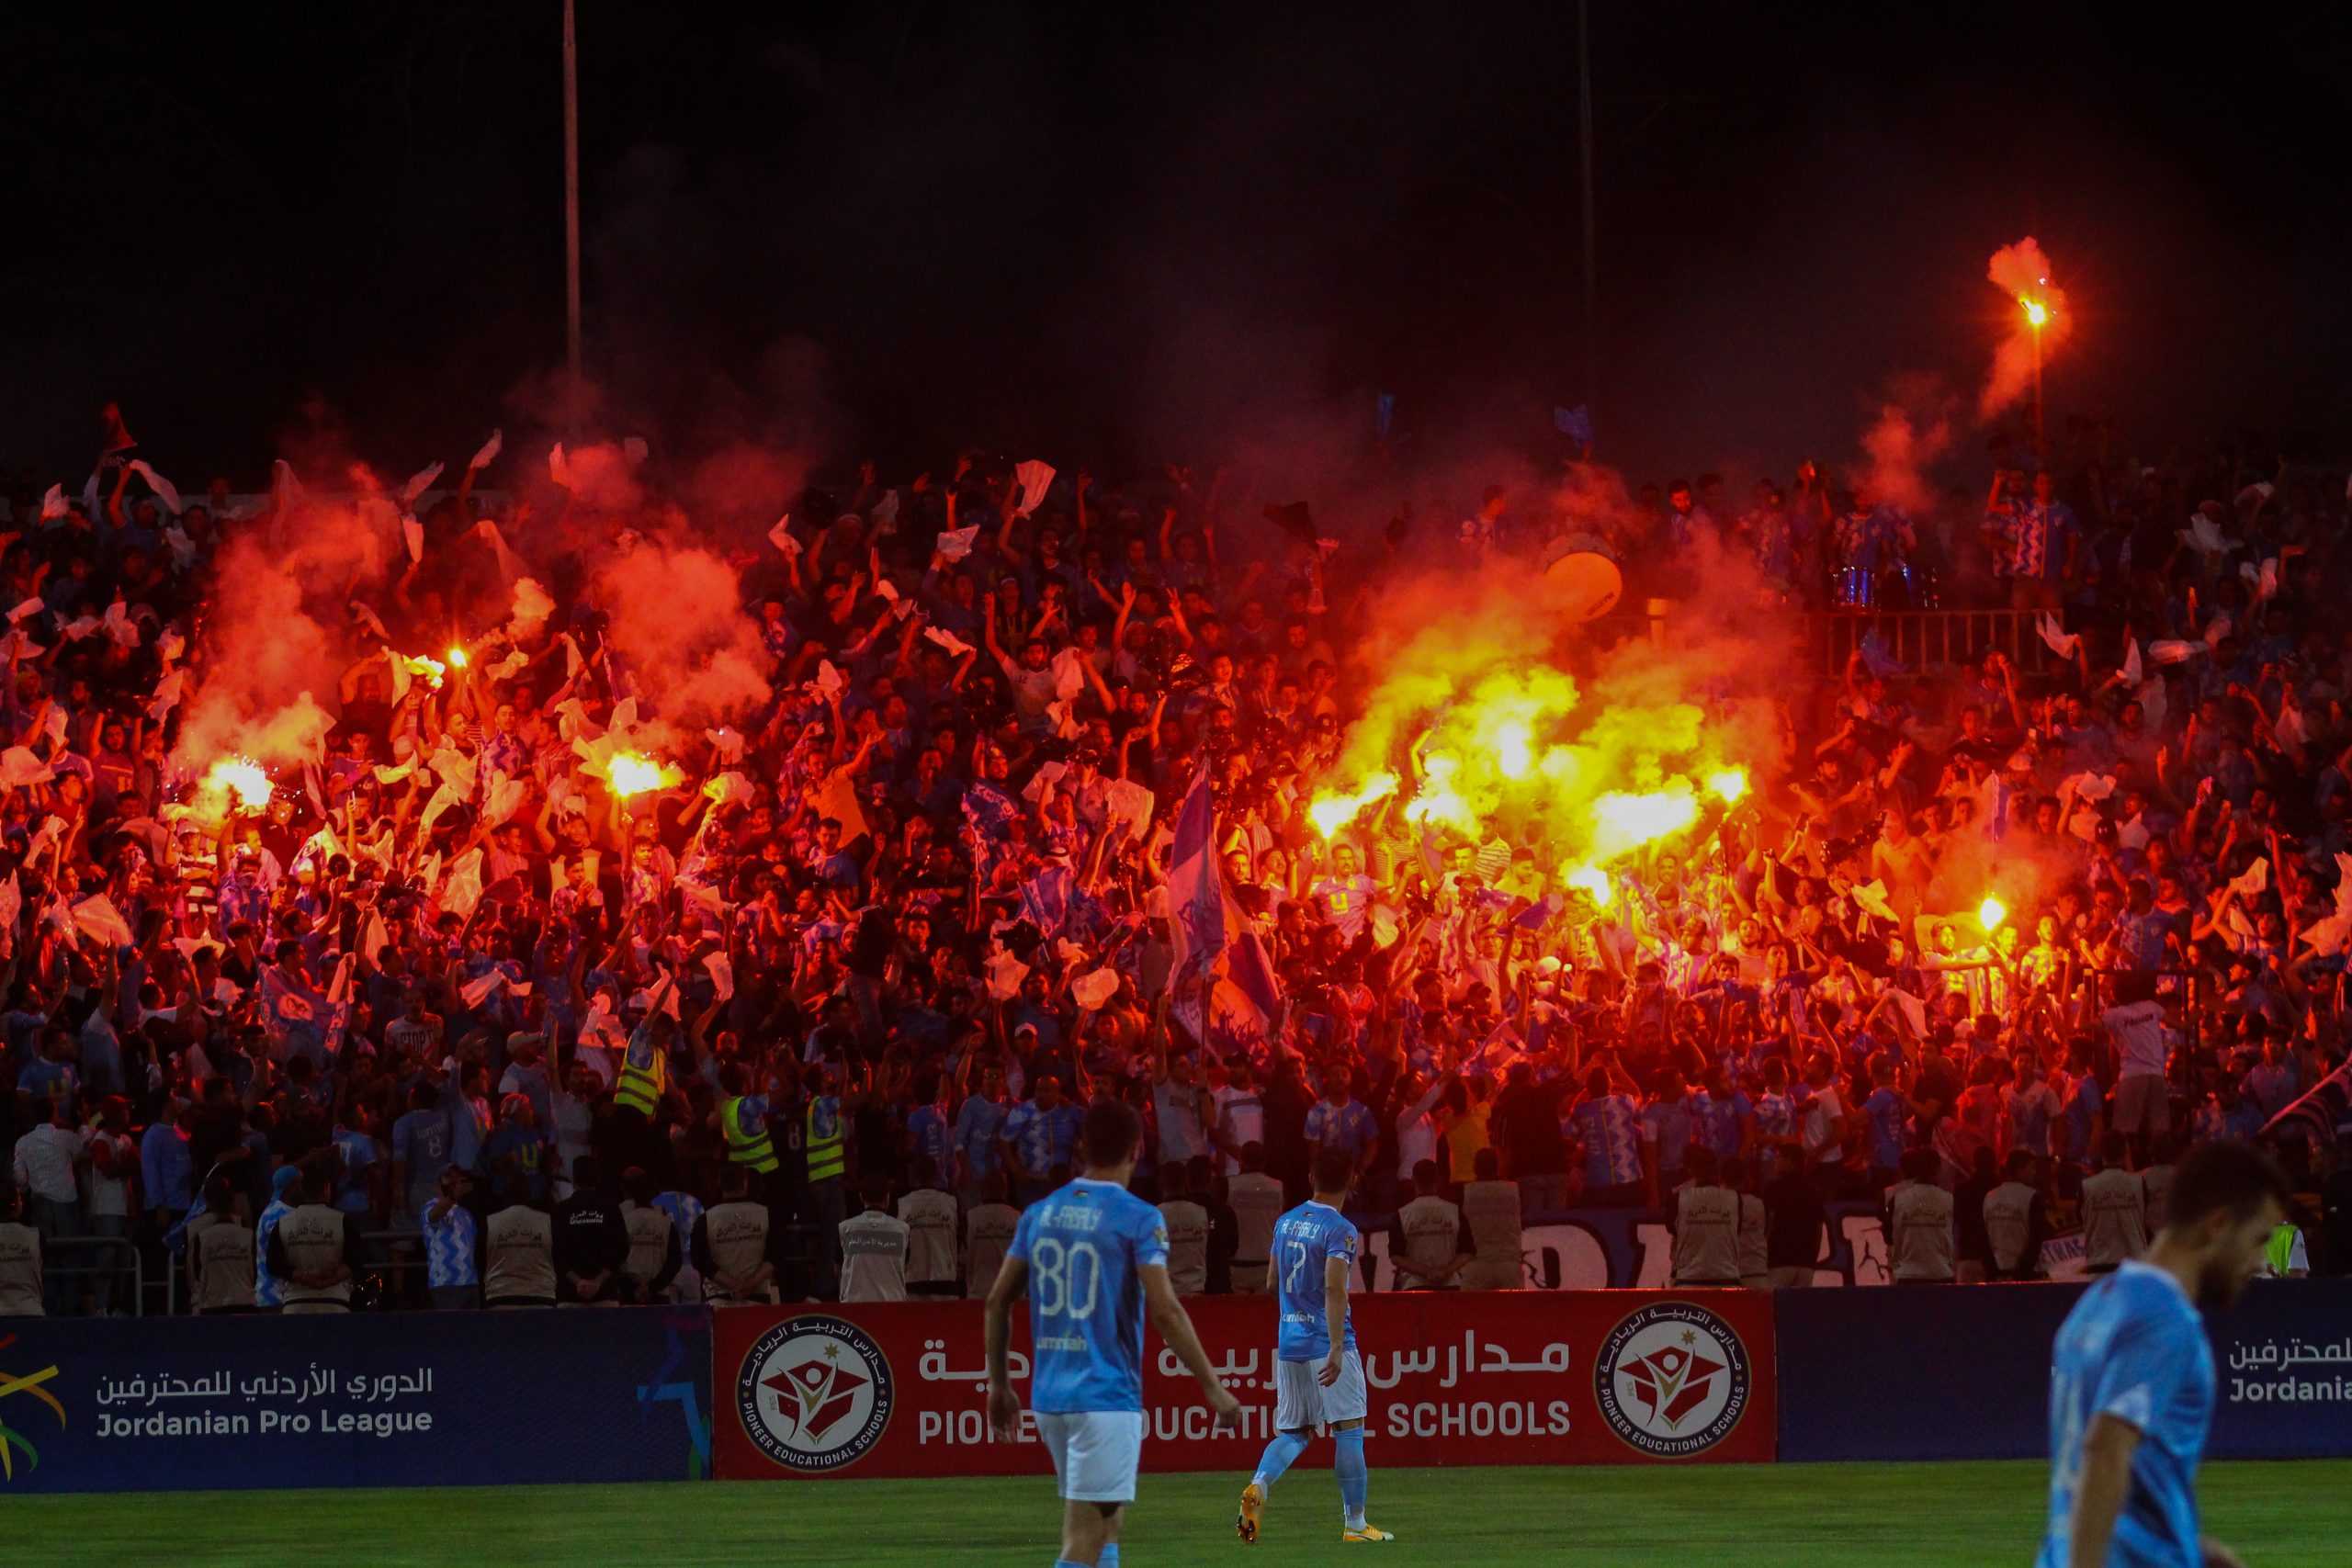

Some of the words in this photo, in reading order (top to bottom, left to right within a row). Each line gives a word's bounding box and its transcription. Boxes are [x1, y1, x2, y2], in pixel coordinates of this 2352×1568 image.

[1033, 1237, 1100, 1320] 80
[1286, 1241, 1306, 1294] 7
[1365, 1329, 1570, 1390] مدارس
[96, 1370, 232, 1407] للمحترفين
[240, 1361, 336, 1404] الأردني
[346, 1367, 433, 1403] الدوري
[2229, 1375, 2352, 1403] Jordania
[96, 1409, 250, 1438] Jordanian
[260, 1409, 311, 1434] Pro
[321, 1408, 433, 1438] League
[742, 1402, 775, 1450] PIONEER
[774, 1445, 856, 1466] EDUCATIONAL
[854, 1399, 888, 1450] SCHOOLS
[1386, 1399, 1571, 1438] SCHOOLS
[1600, 1388, 1634, 1437] PIONEER
[1631, 1431, 1713, 1453] EDUCATIONAL
[1712, 1385, 1746, 1437] SCHOOLS
